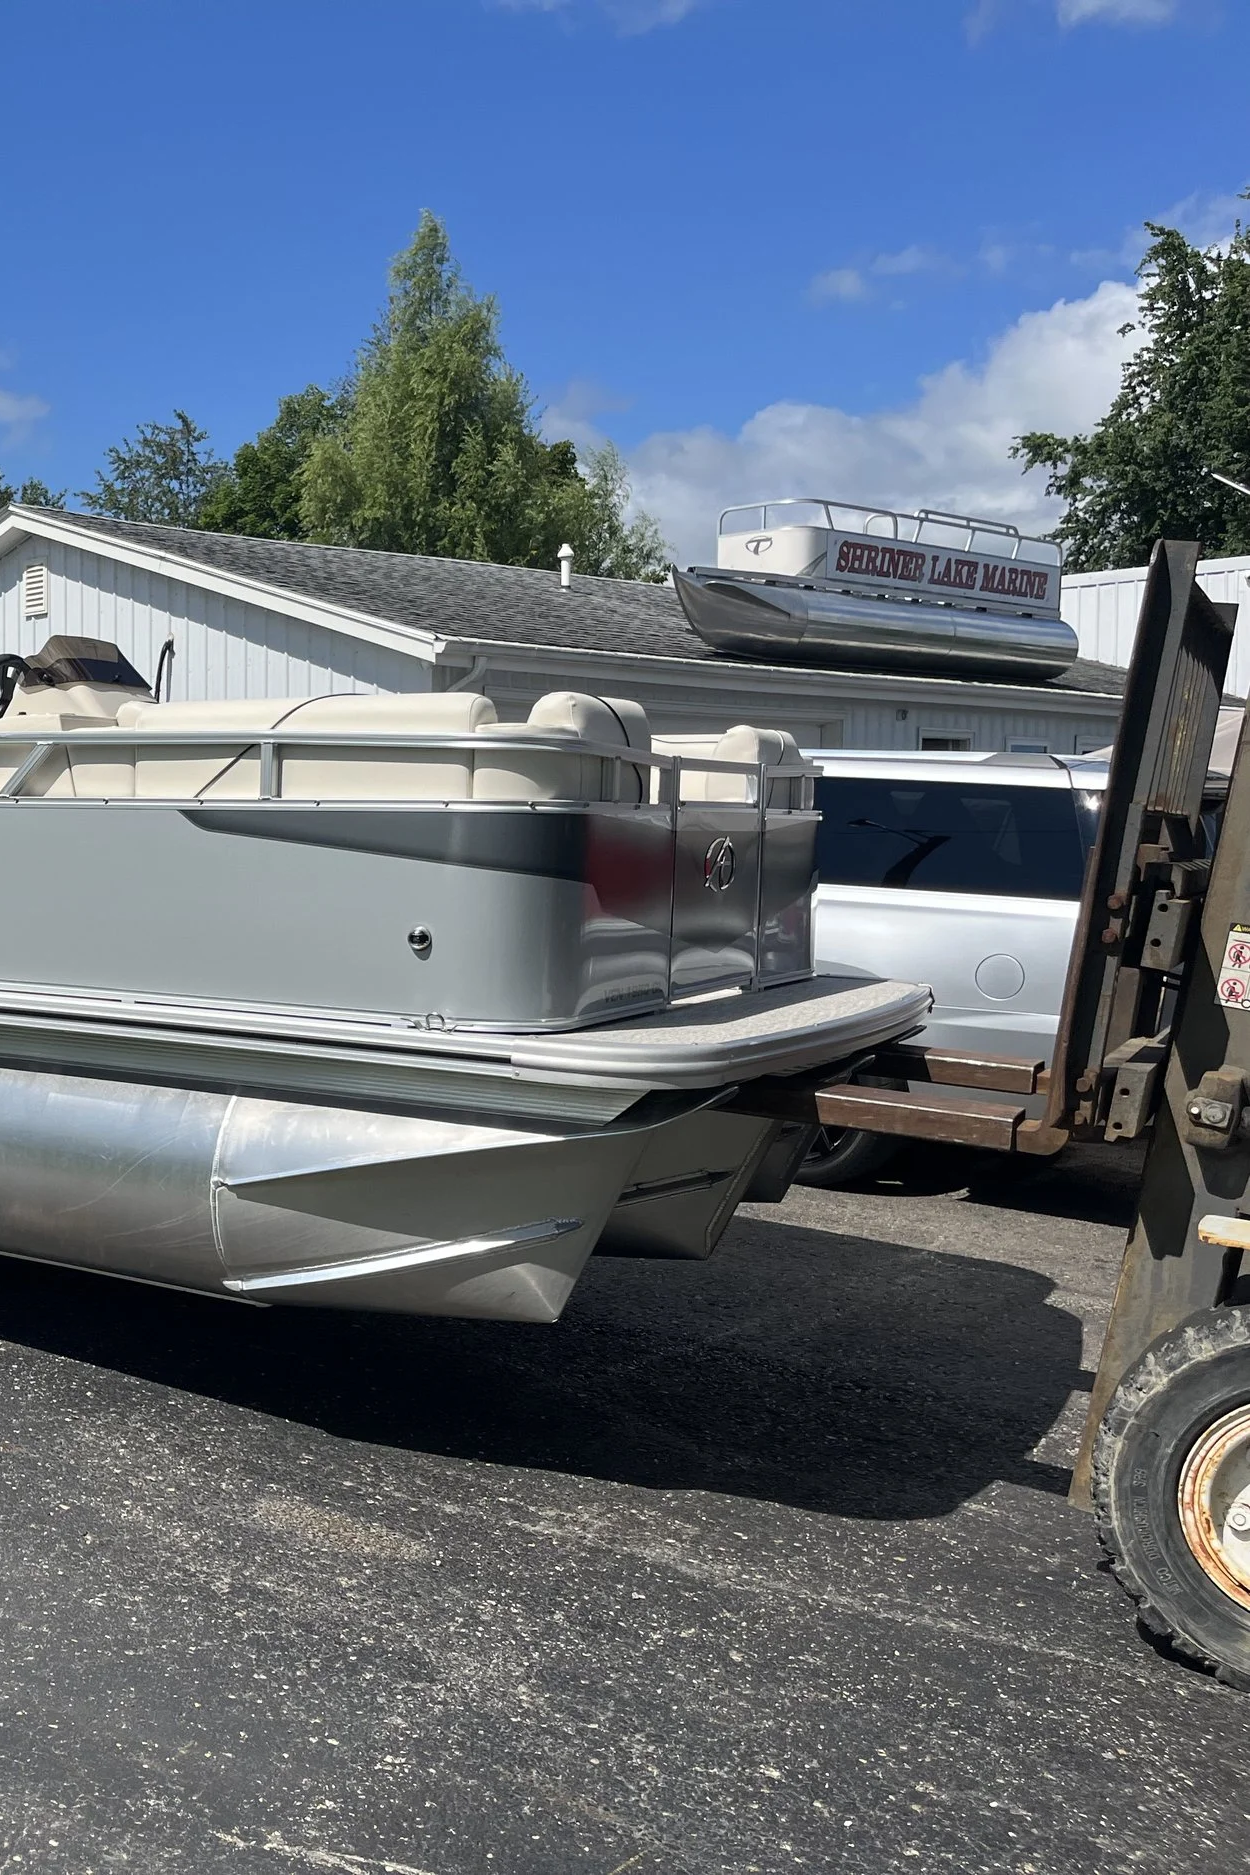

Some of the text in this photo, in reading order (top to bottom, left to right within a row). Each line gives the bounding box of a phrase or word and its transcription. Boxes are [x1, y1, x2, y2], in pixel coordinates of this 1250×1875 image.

[836, 540, 1049, 600] SHRINER LAKE MARINE
